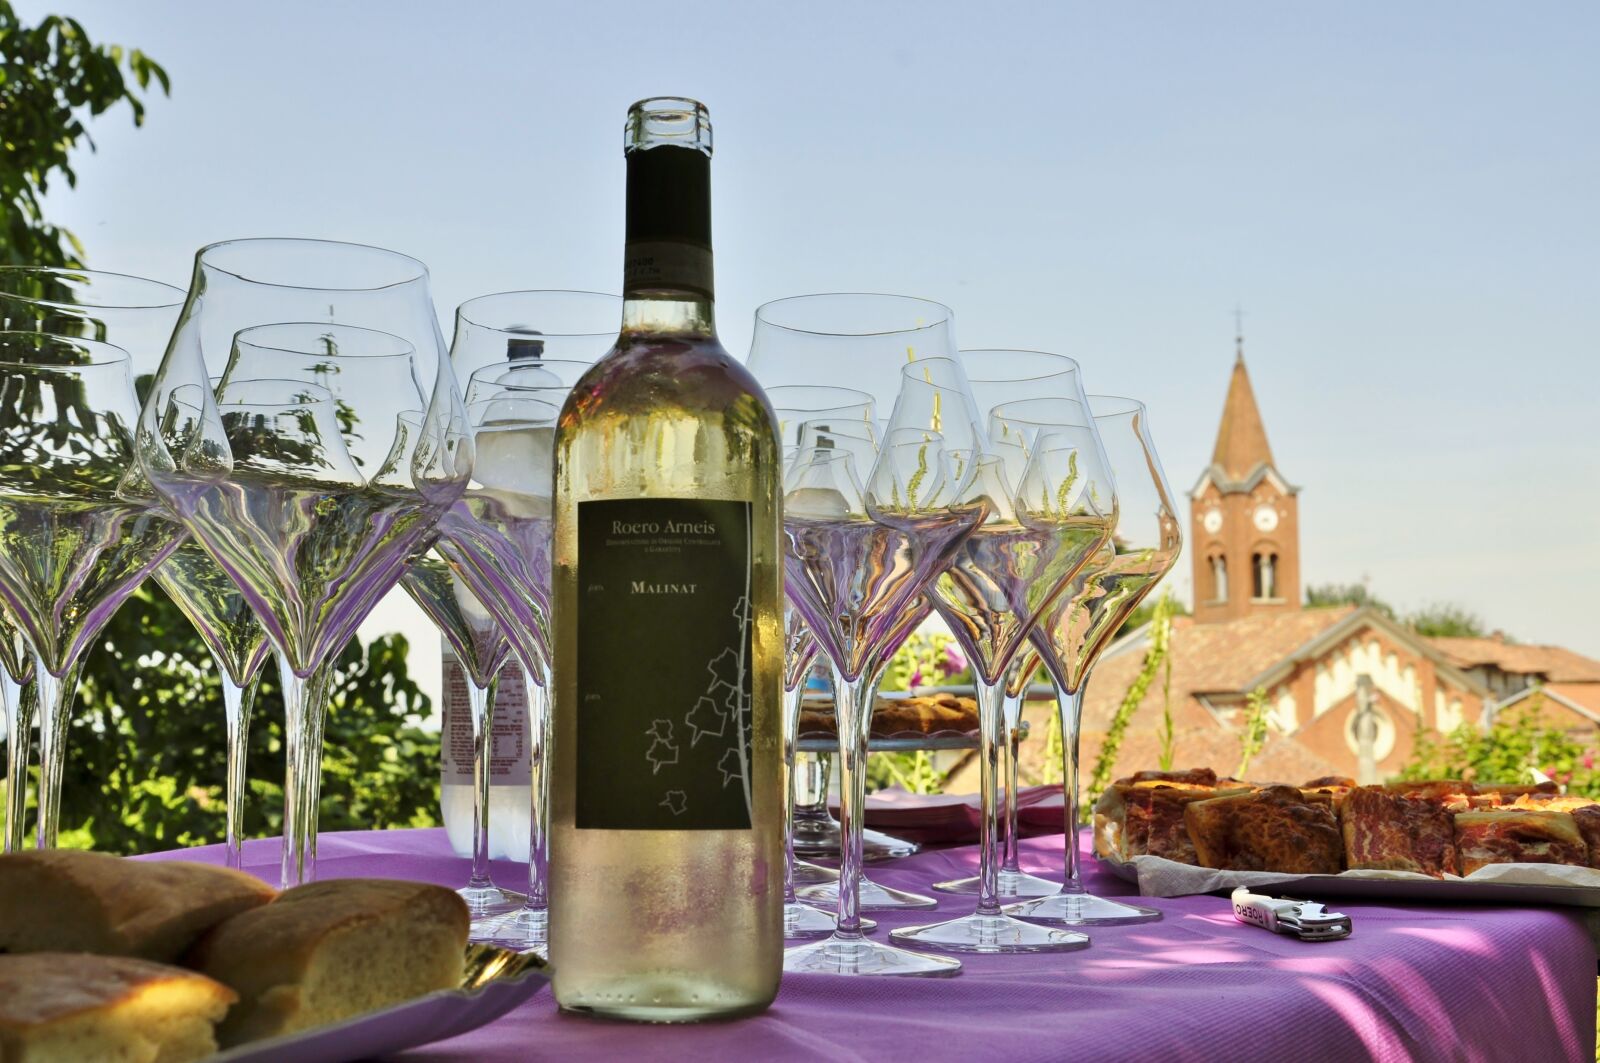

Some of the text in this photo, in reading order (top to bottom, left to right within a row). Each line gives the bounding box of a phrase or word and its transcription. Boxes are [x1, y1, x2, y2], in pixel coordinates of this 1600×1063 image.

[612, 520, 716, 535] Roero Arneis
[631, 581, 697, 594] MALINAT
[1236, 903, 1264, 924] ROERO
